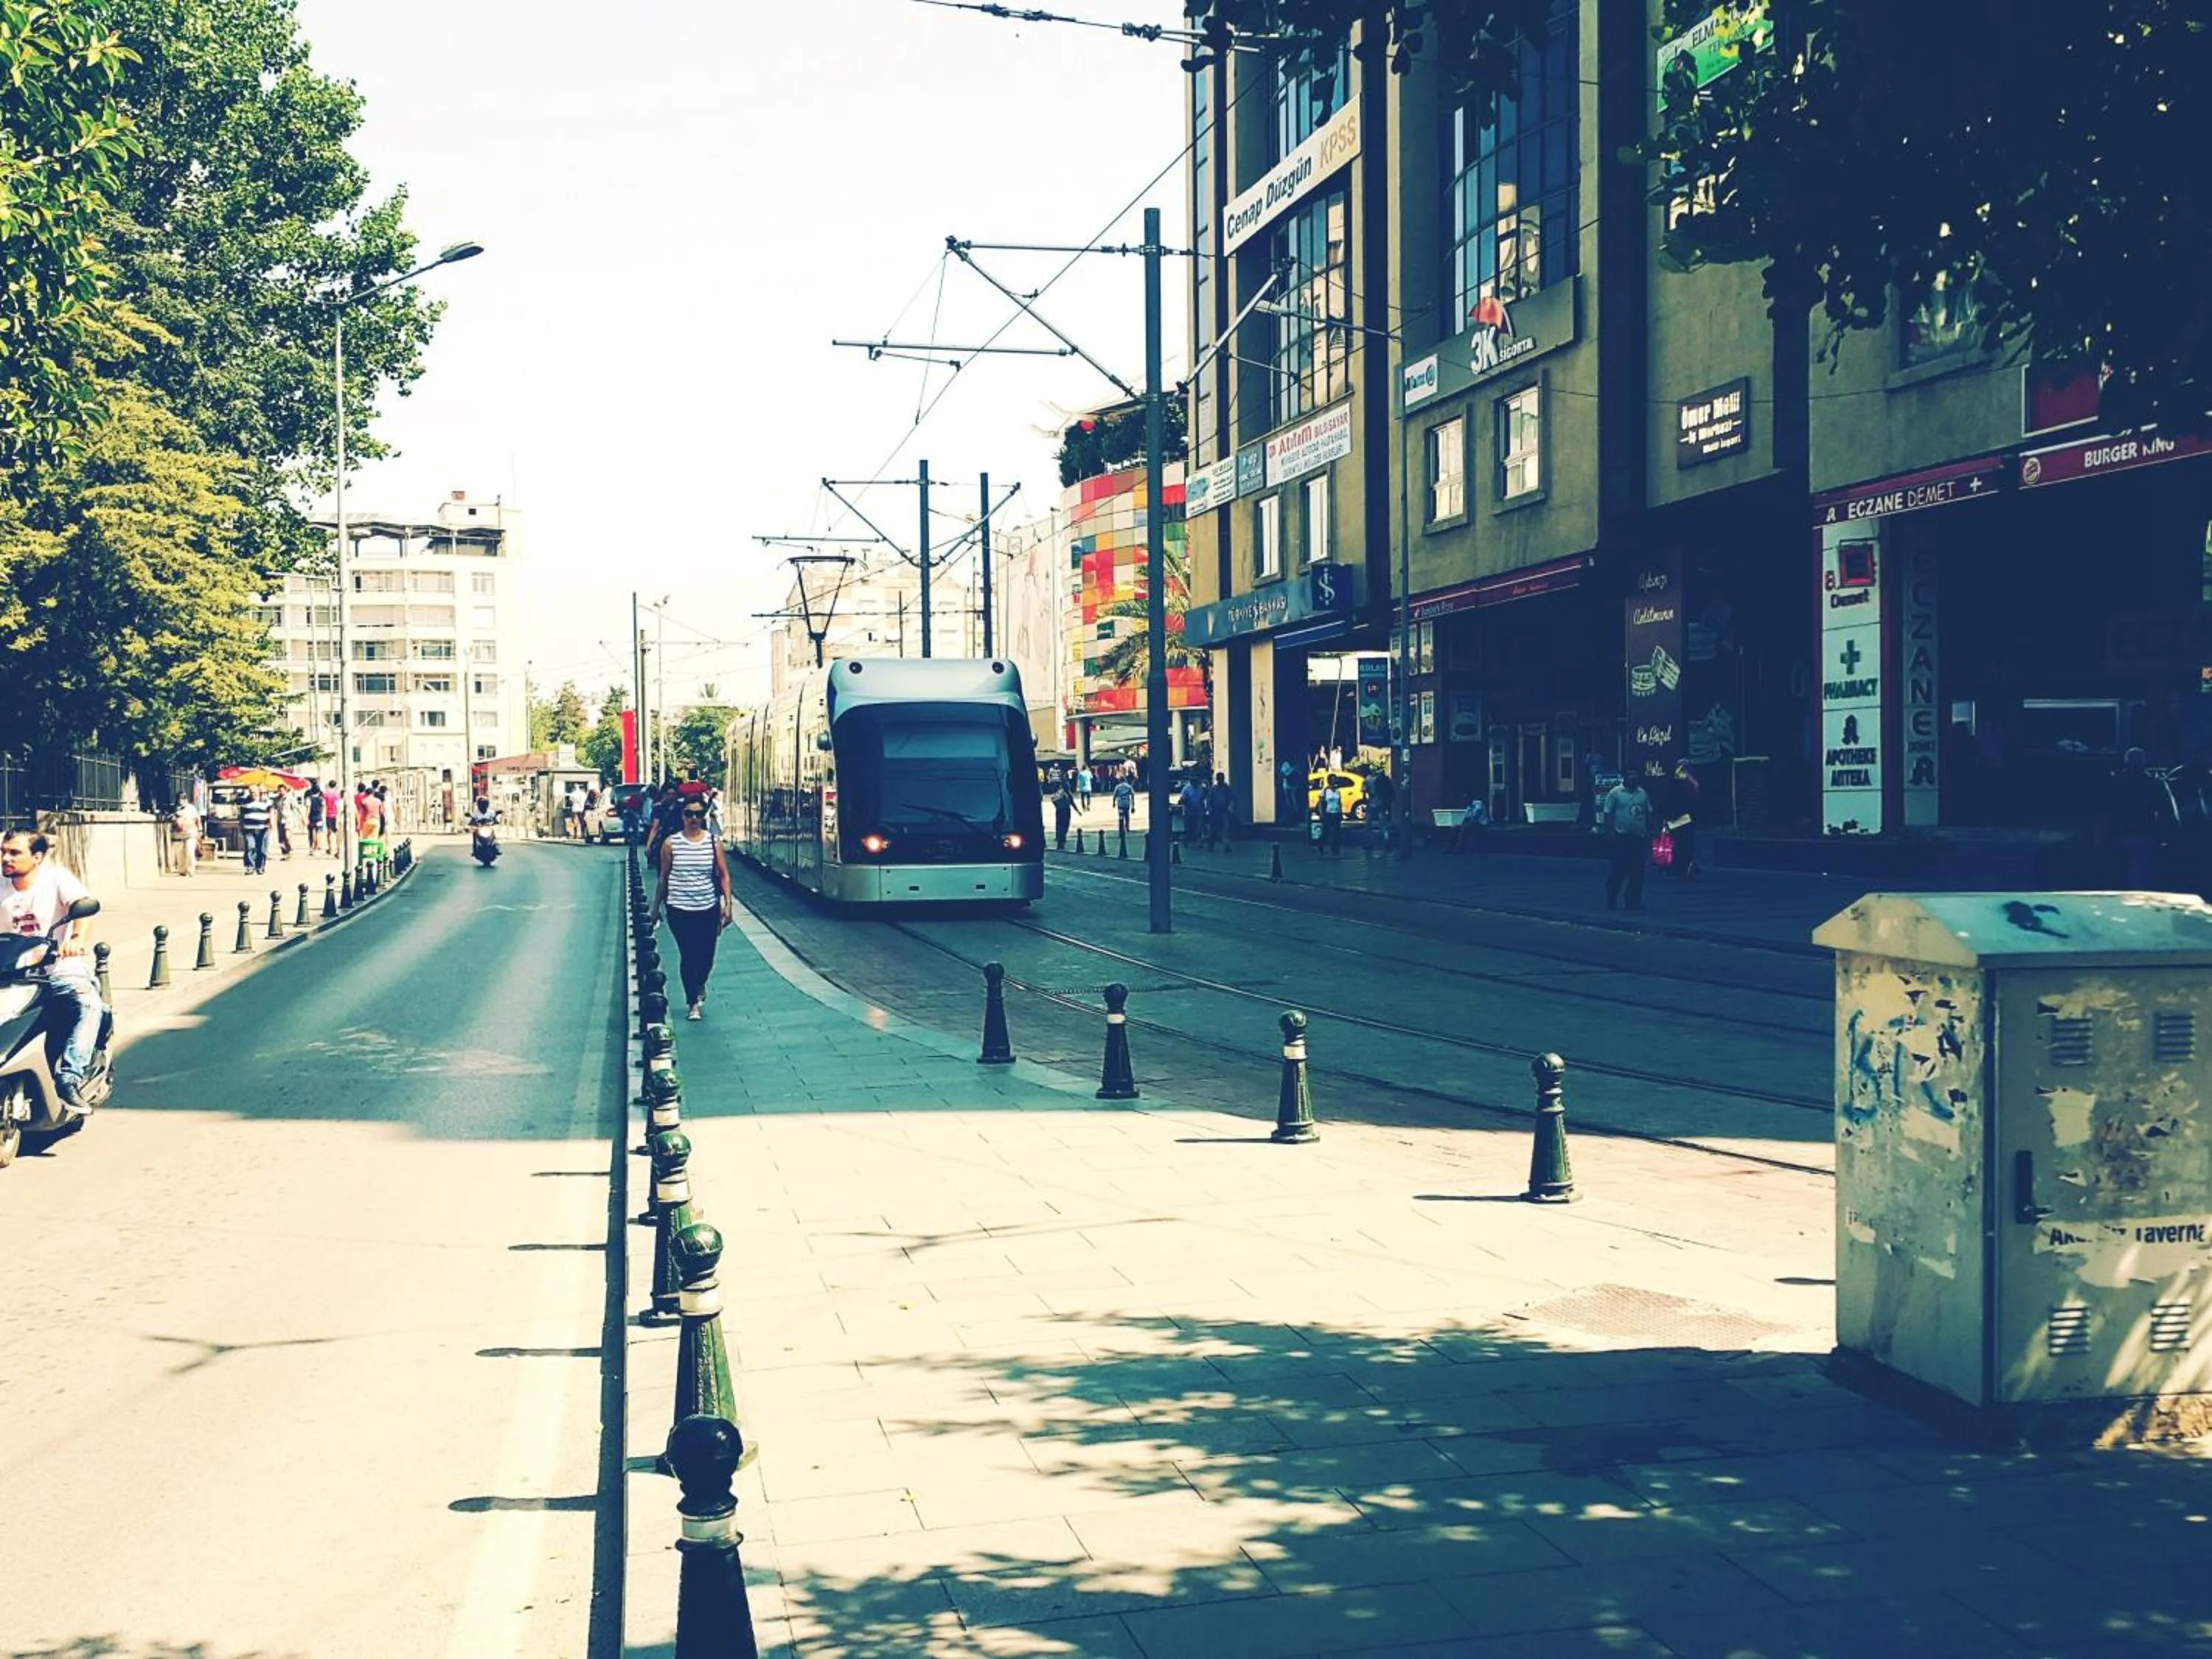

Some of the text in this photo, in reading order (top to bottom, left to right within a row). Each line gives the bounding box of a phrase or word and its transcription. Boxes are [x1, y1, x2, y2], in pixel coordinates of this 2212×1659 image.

[1227, 115, 1356, 239] Cenap Düzgün KPSS
[1470, 325, 1499, 375] 3K
[2084, 441, 2138, 468] BURGER
[1848, 492, 1903, 519] ECZANE
[1907, 481, 1956, 507] DEMET
[1825, 746, 1877, 766] APOTHEKE
